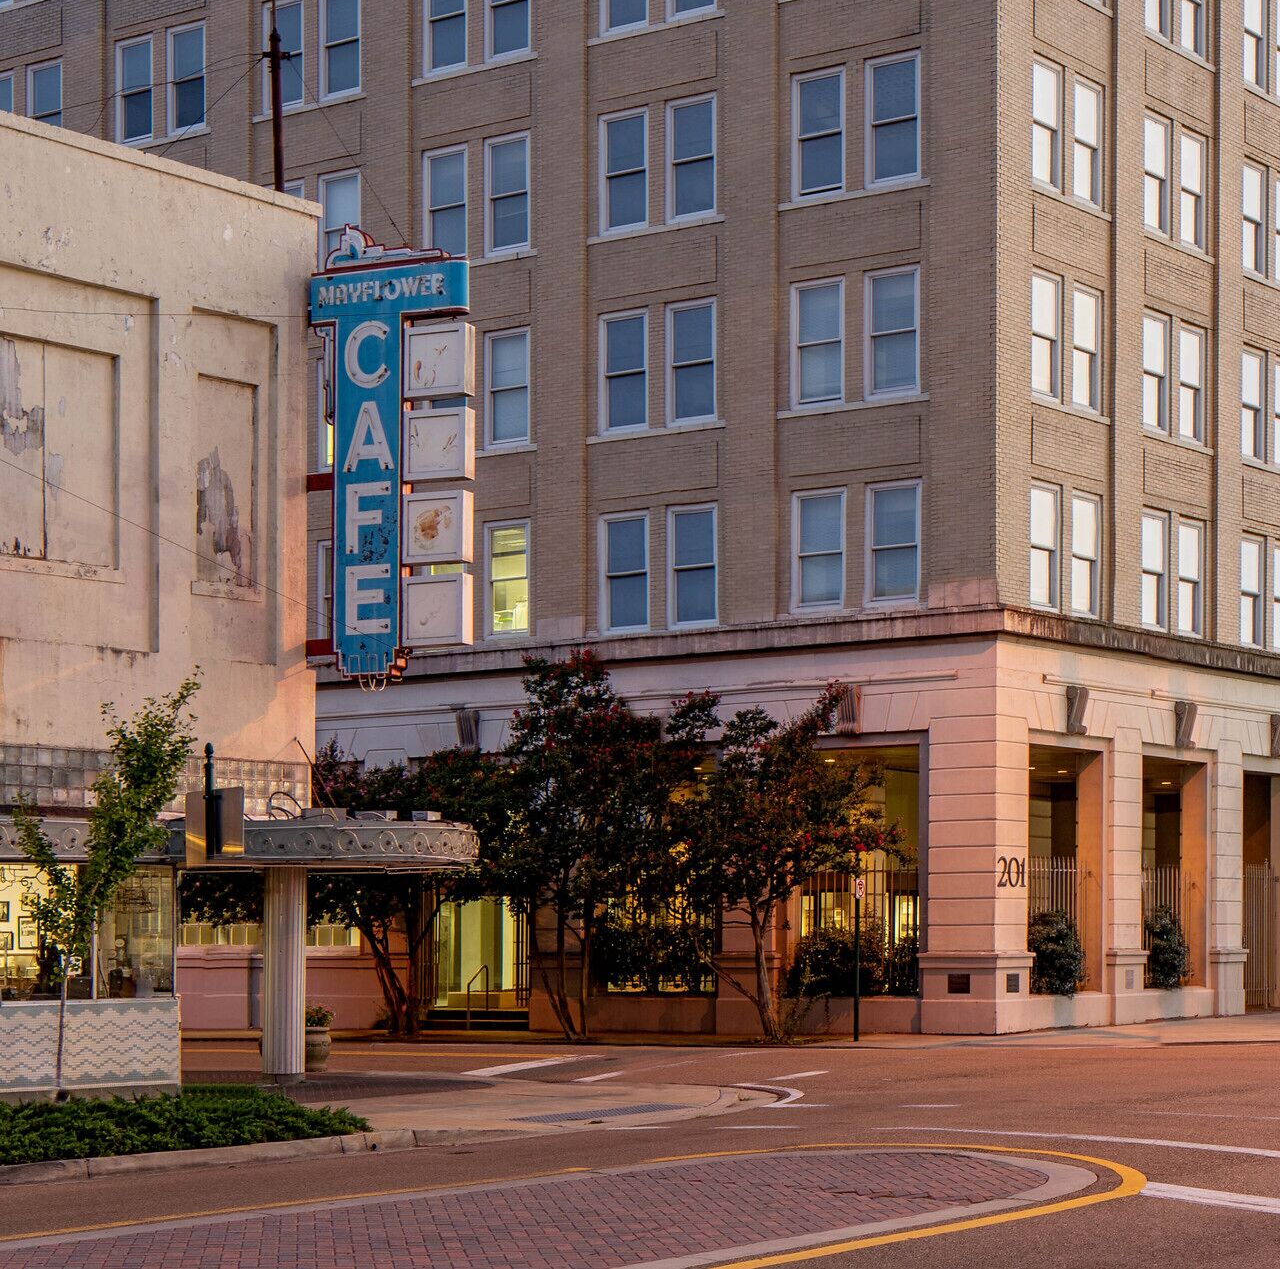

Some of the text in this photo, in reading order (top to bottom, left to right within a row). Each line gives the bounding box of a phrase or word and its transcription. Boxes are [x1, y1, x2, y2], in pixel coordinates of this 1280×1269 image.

[318, 273, 447, 306] MAYFLOWER
[343, 320, 395, 636] CAFE
[996, 855, 1027, 888] 201
